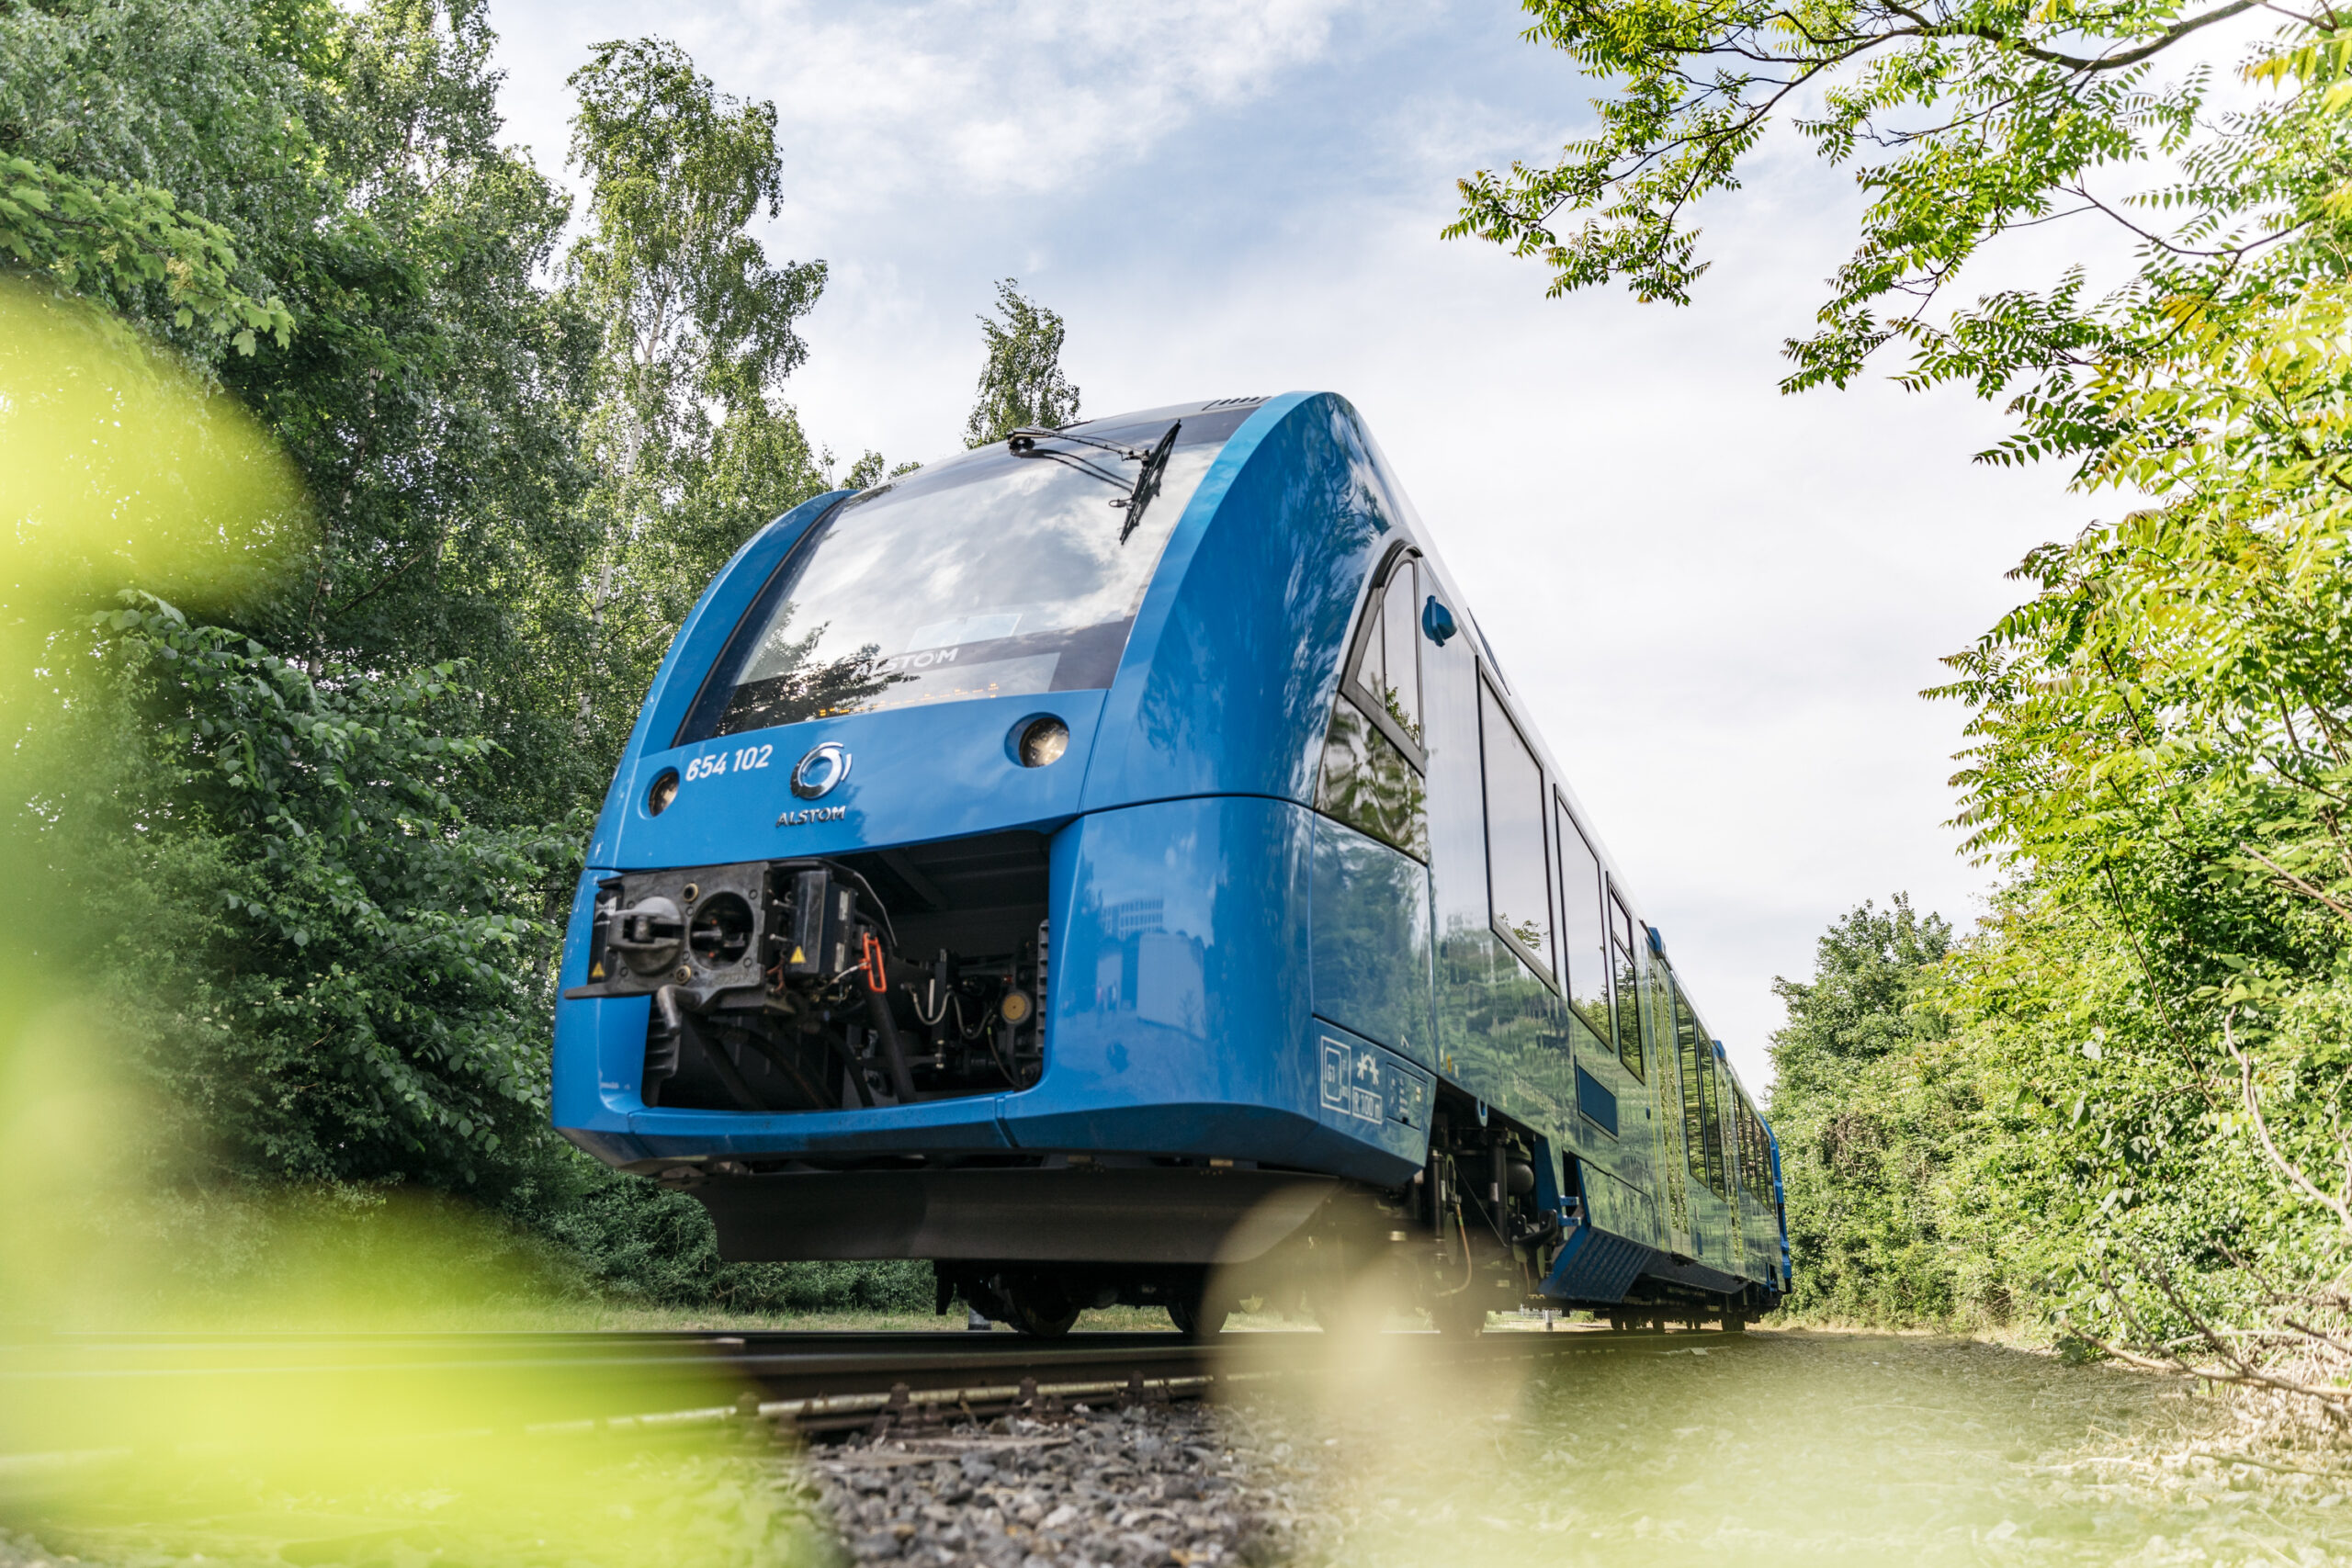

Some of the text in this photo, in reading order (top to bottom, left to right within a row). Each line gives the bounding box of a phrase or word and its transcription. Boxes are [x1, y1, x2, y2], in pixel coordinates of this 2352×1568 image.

[850, 648, 959, 681] ALSTOM
[685, 744, 774, 782] 654 102
[775, 805, 846, 828] ALSTOM
[1352, 1091, 1360, 1113] R
[1361, 1093, 1374, 1117] 100
